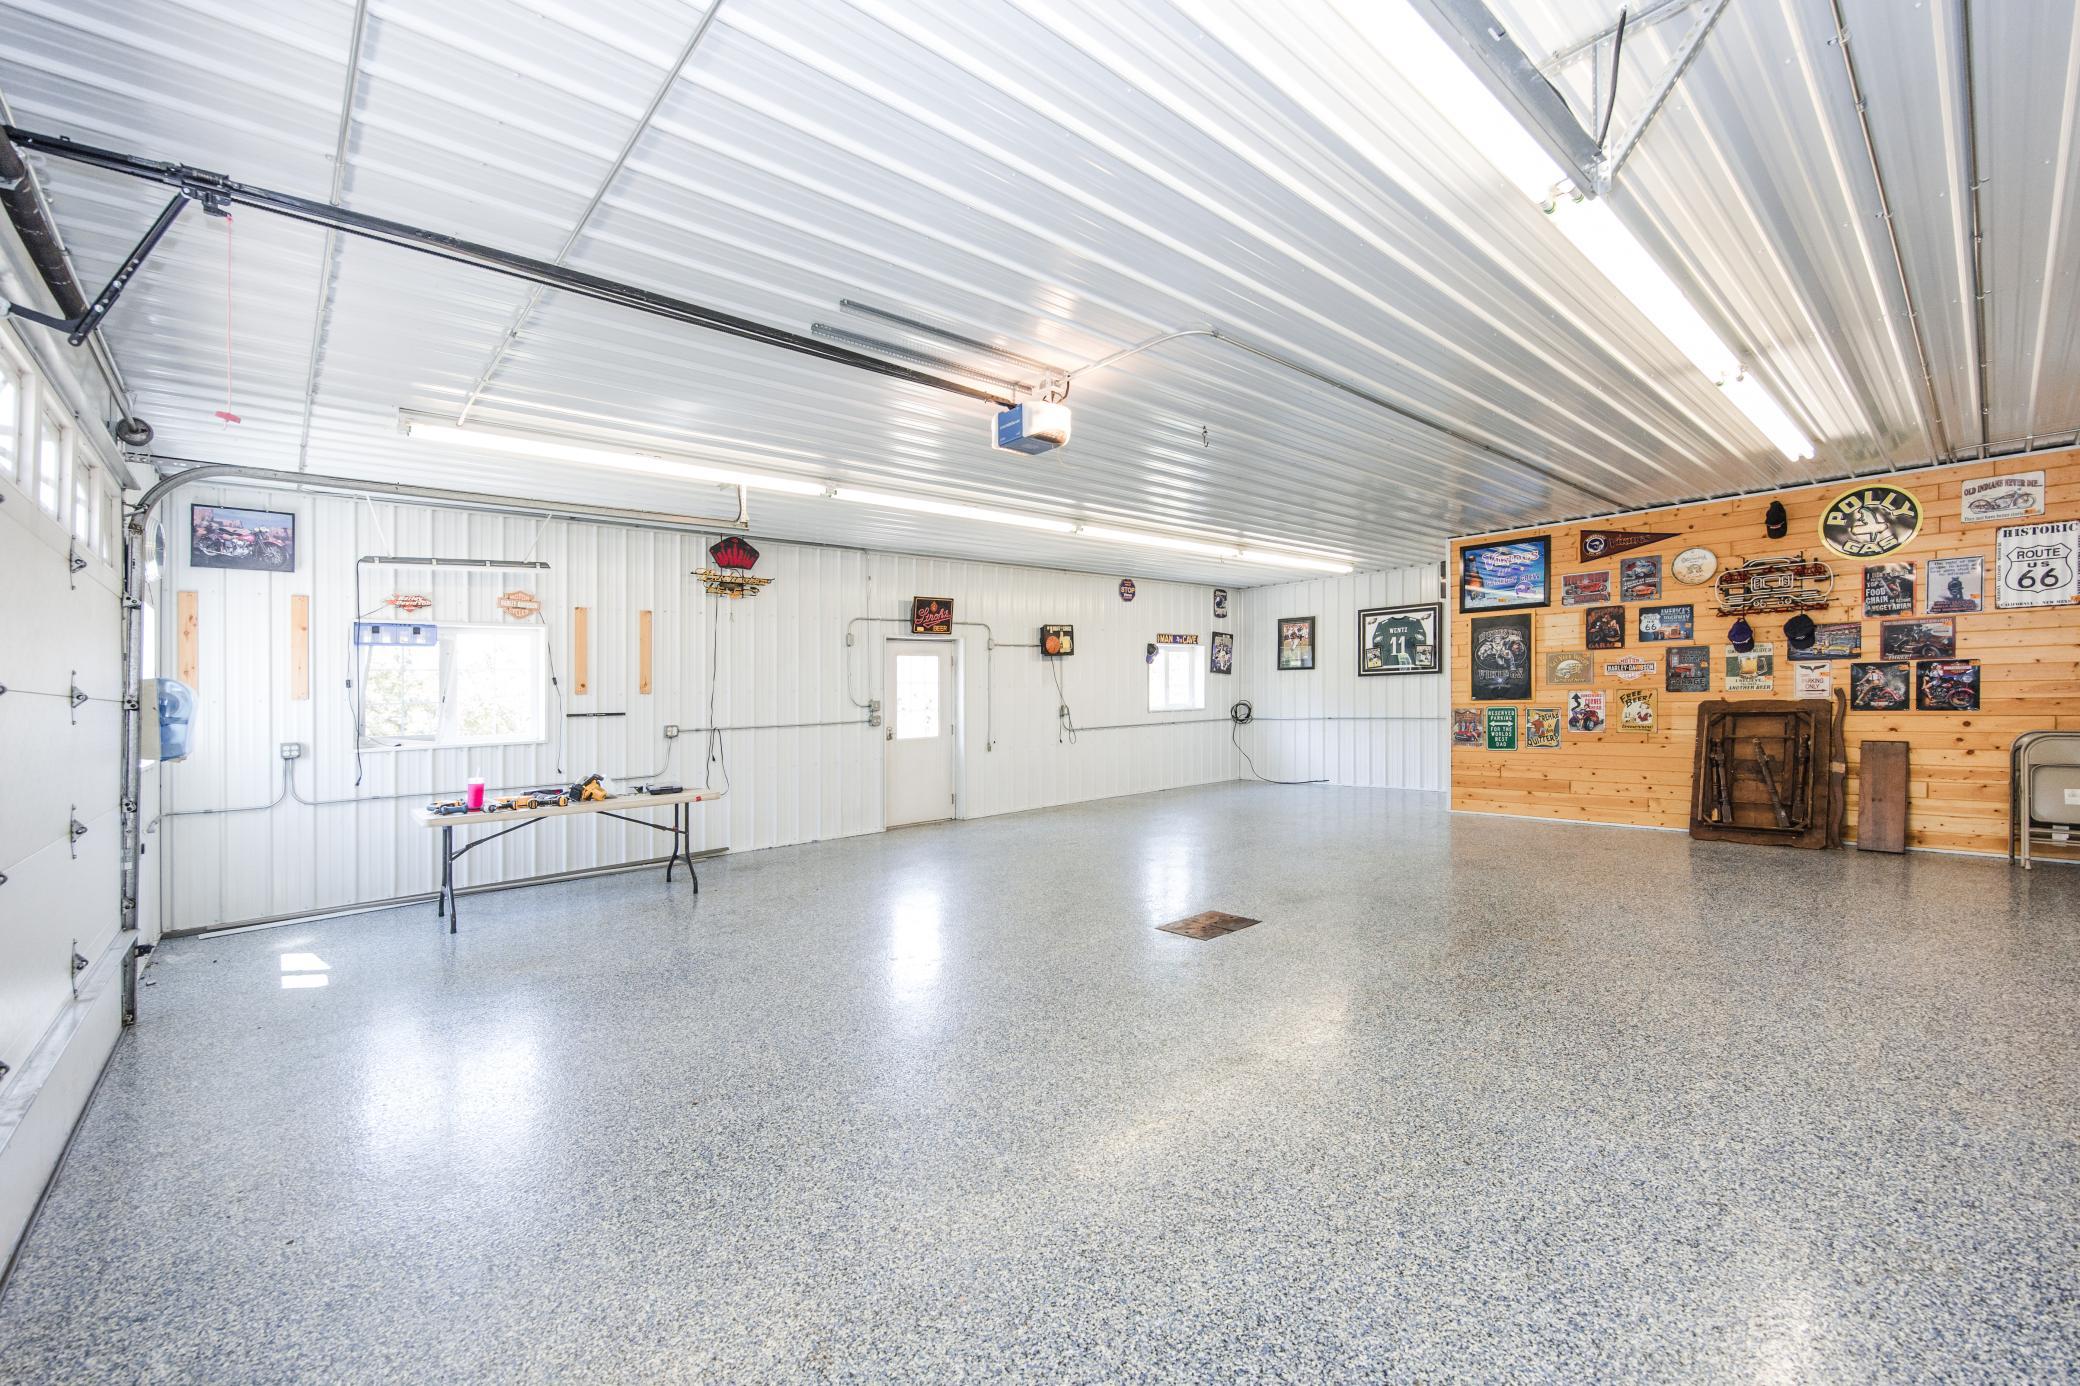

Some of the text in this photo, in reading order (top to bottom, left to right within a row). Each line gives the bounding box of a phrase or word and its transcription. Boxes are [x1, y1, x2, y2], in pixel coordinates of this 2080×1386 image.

[1964, 487, 1976, 496] OLD
[1978, 480, 2003, 492] INDIANS
[2004, 479, 2025, 487] NEVER
[1827, 491, 1914, 526] POLLY
[2003, 522, 2078, 538] HISTORIC
[1842, 536, 1898, 553] GAS
[2017, 548, 2060, 559] ROUTE
[2018, 568, 2059, 588] 66
[1866, 588, 1885, 596] FOOD
[1866, 596, 1888, 604] CHAIN
[1872, 602, 1912, 611] VEGETARIAN
[1160, 635, 1197, 644] MAN CAVE
[1390, 636, 1406, 655] 11
[1620, 691, 1642, 704] FREE
[1626, 693, 1652, 708] BEER!
[1528, 734, 1560, 746] QUITTERS
